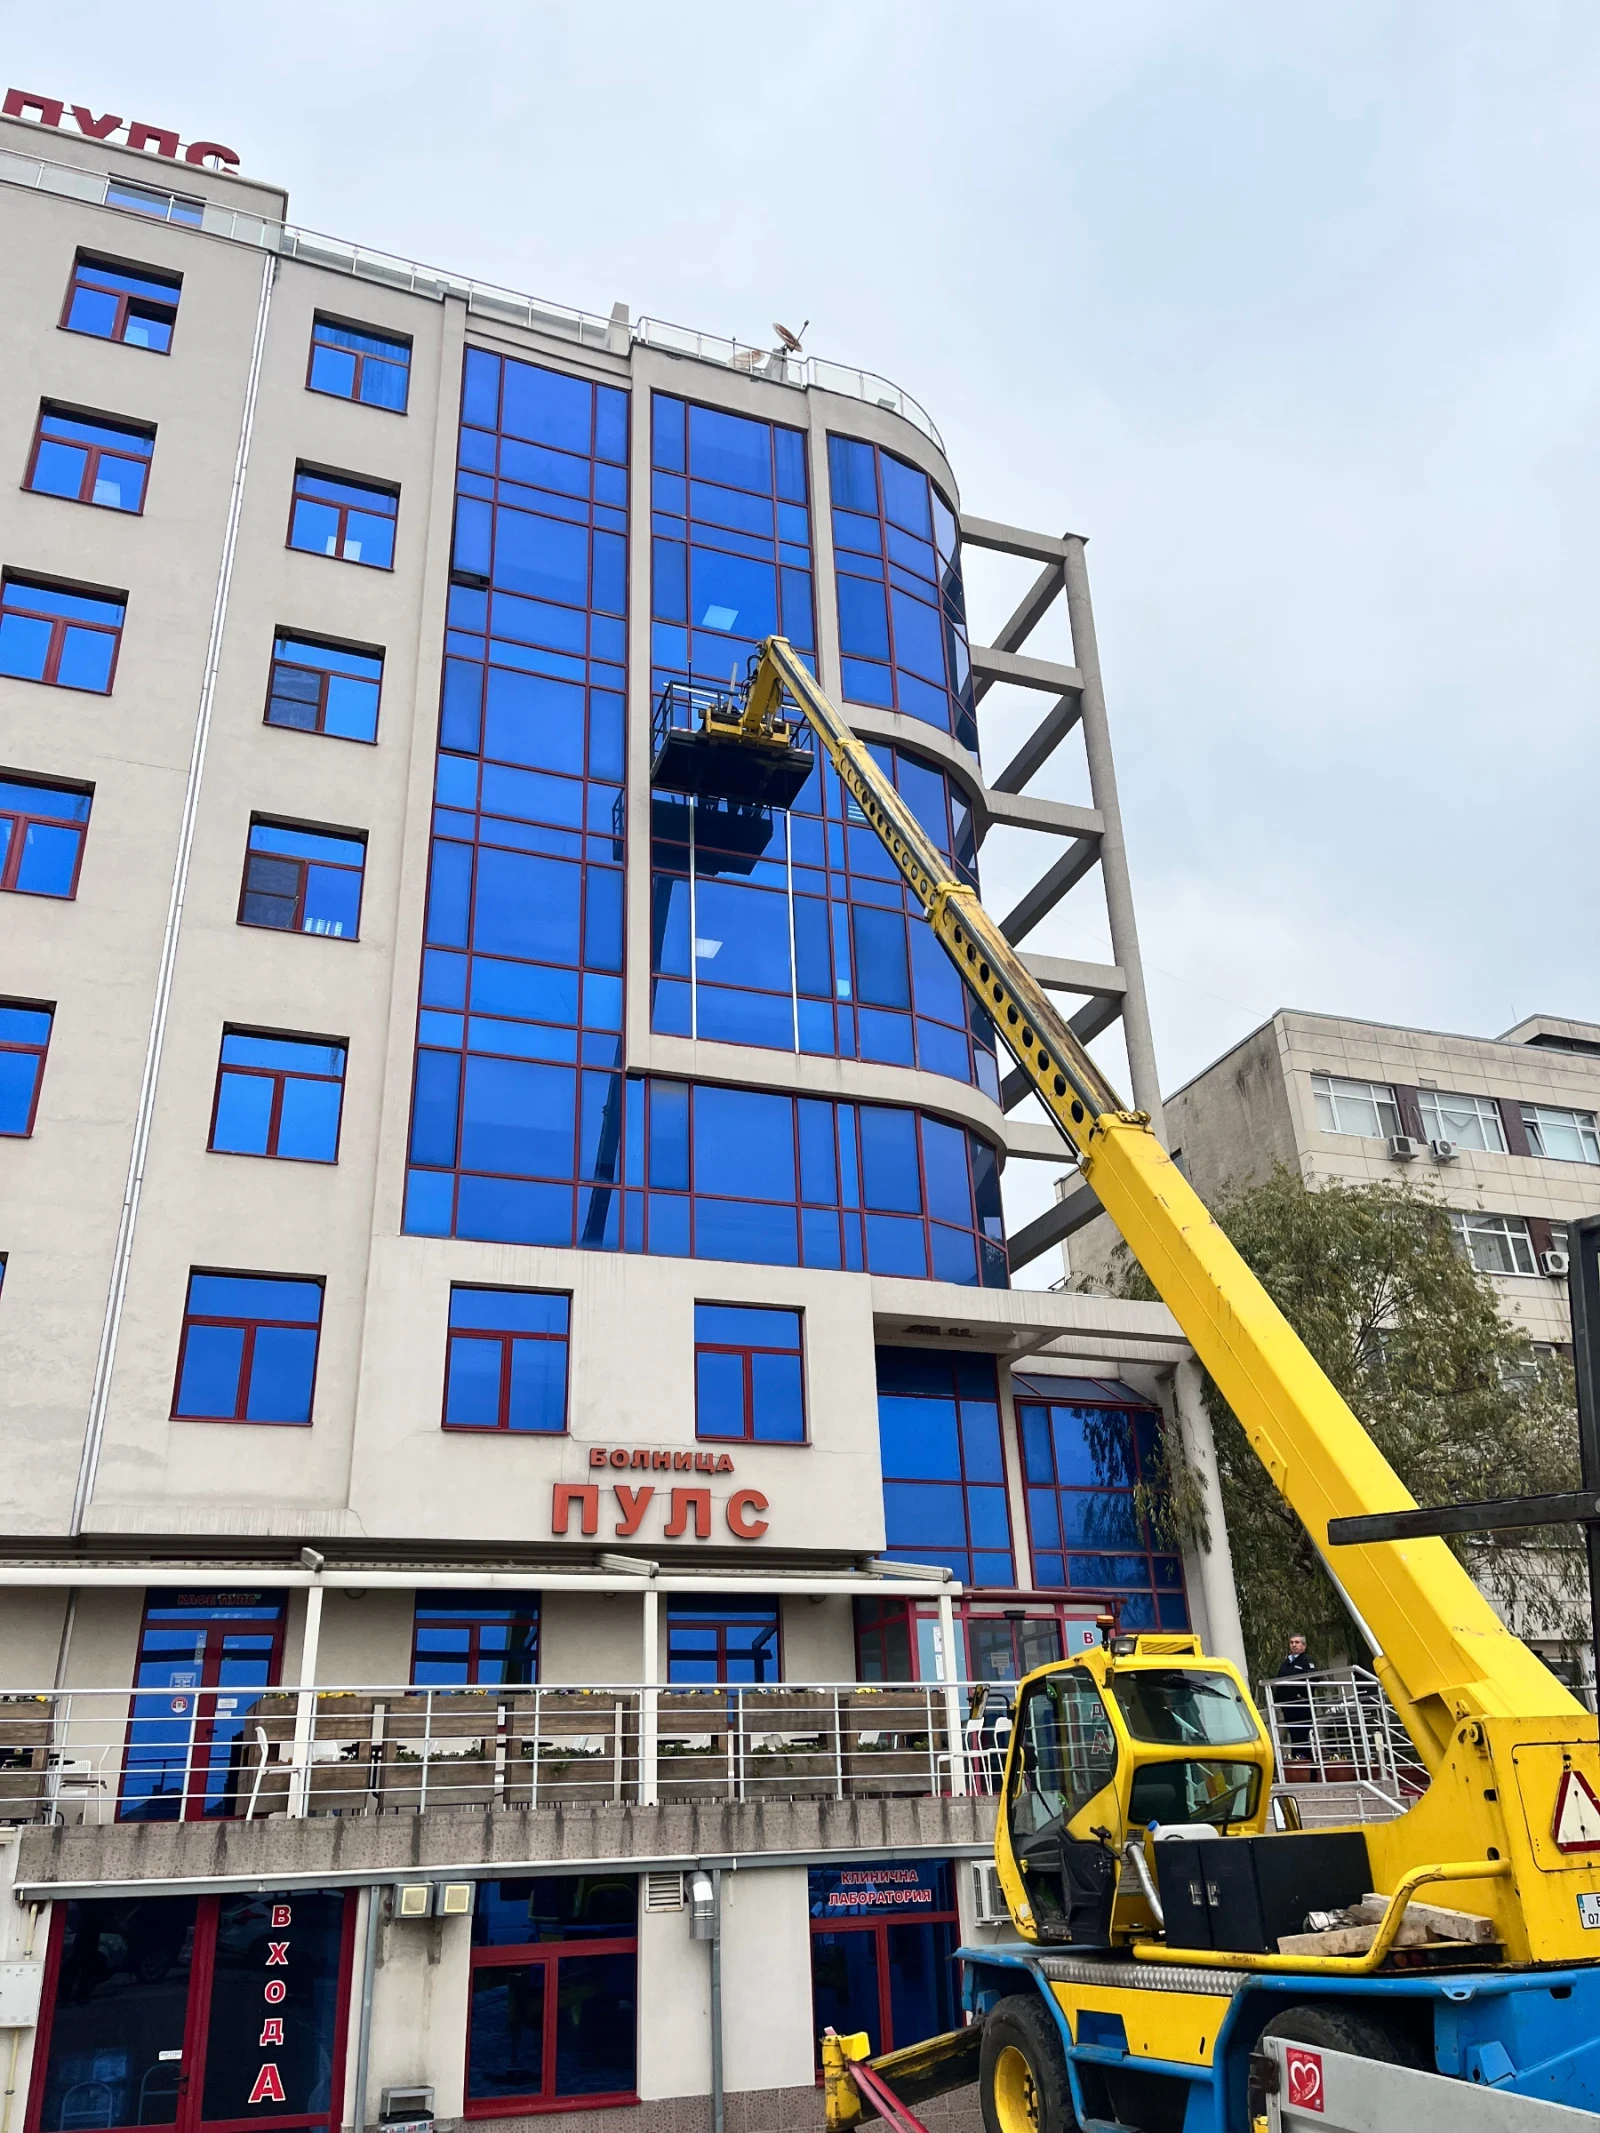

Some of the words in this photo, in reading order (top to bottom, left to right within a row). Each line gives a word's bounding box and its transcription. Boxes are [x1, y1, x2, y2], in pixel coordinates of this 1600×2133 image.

[590, 1448, 735, 1474] БОЛНИЦА
[552, 1483, 770, 1539] ПУЛС
[178, 1594, 216, 1605] КАФЕ
[220, 1594, 257, 1605] ПУЛС
[841, 1869, 919, 1884] КЛИНИЧНА
[829, 1889, 932, 1906] ЛАБОРАТОРИЯ
